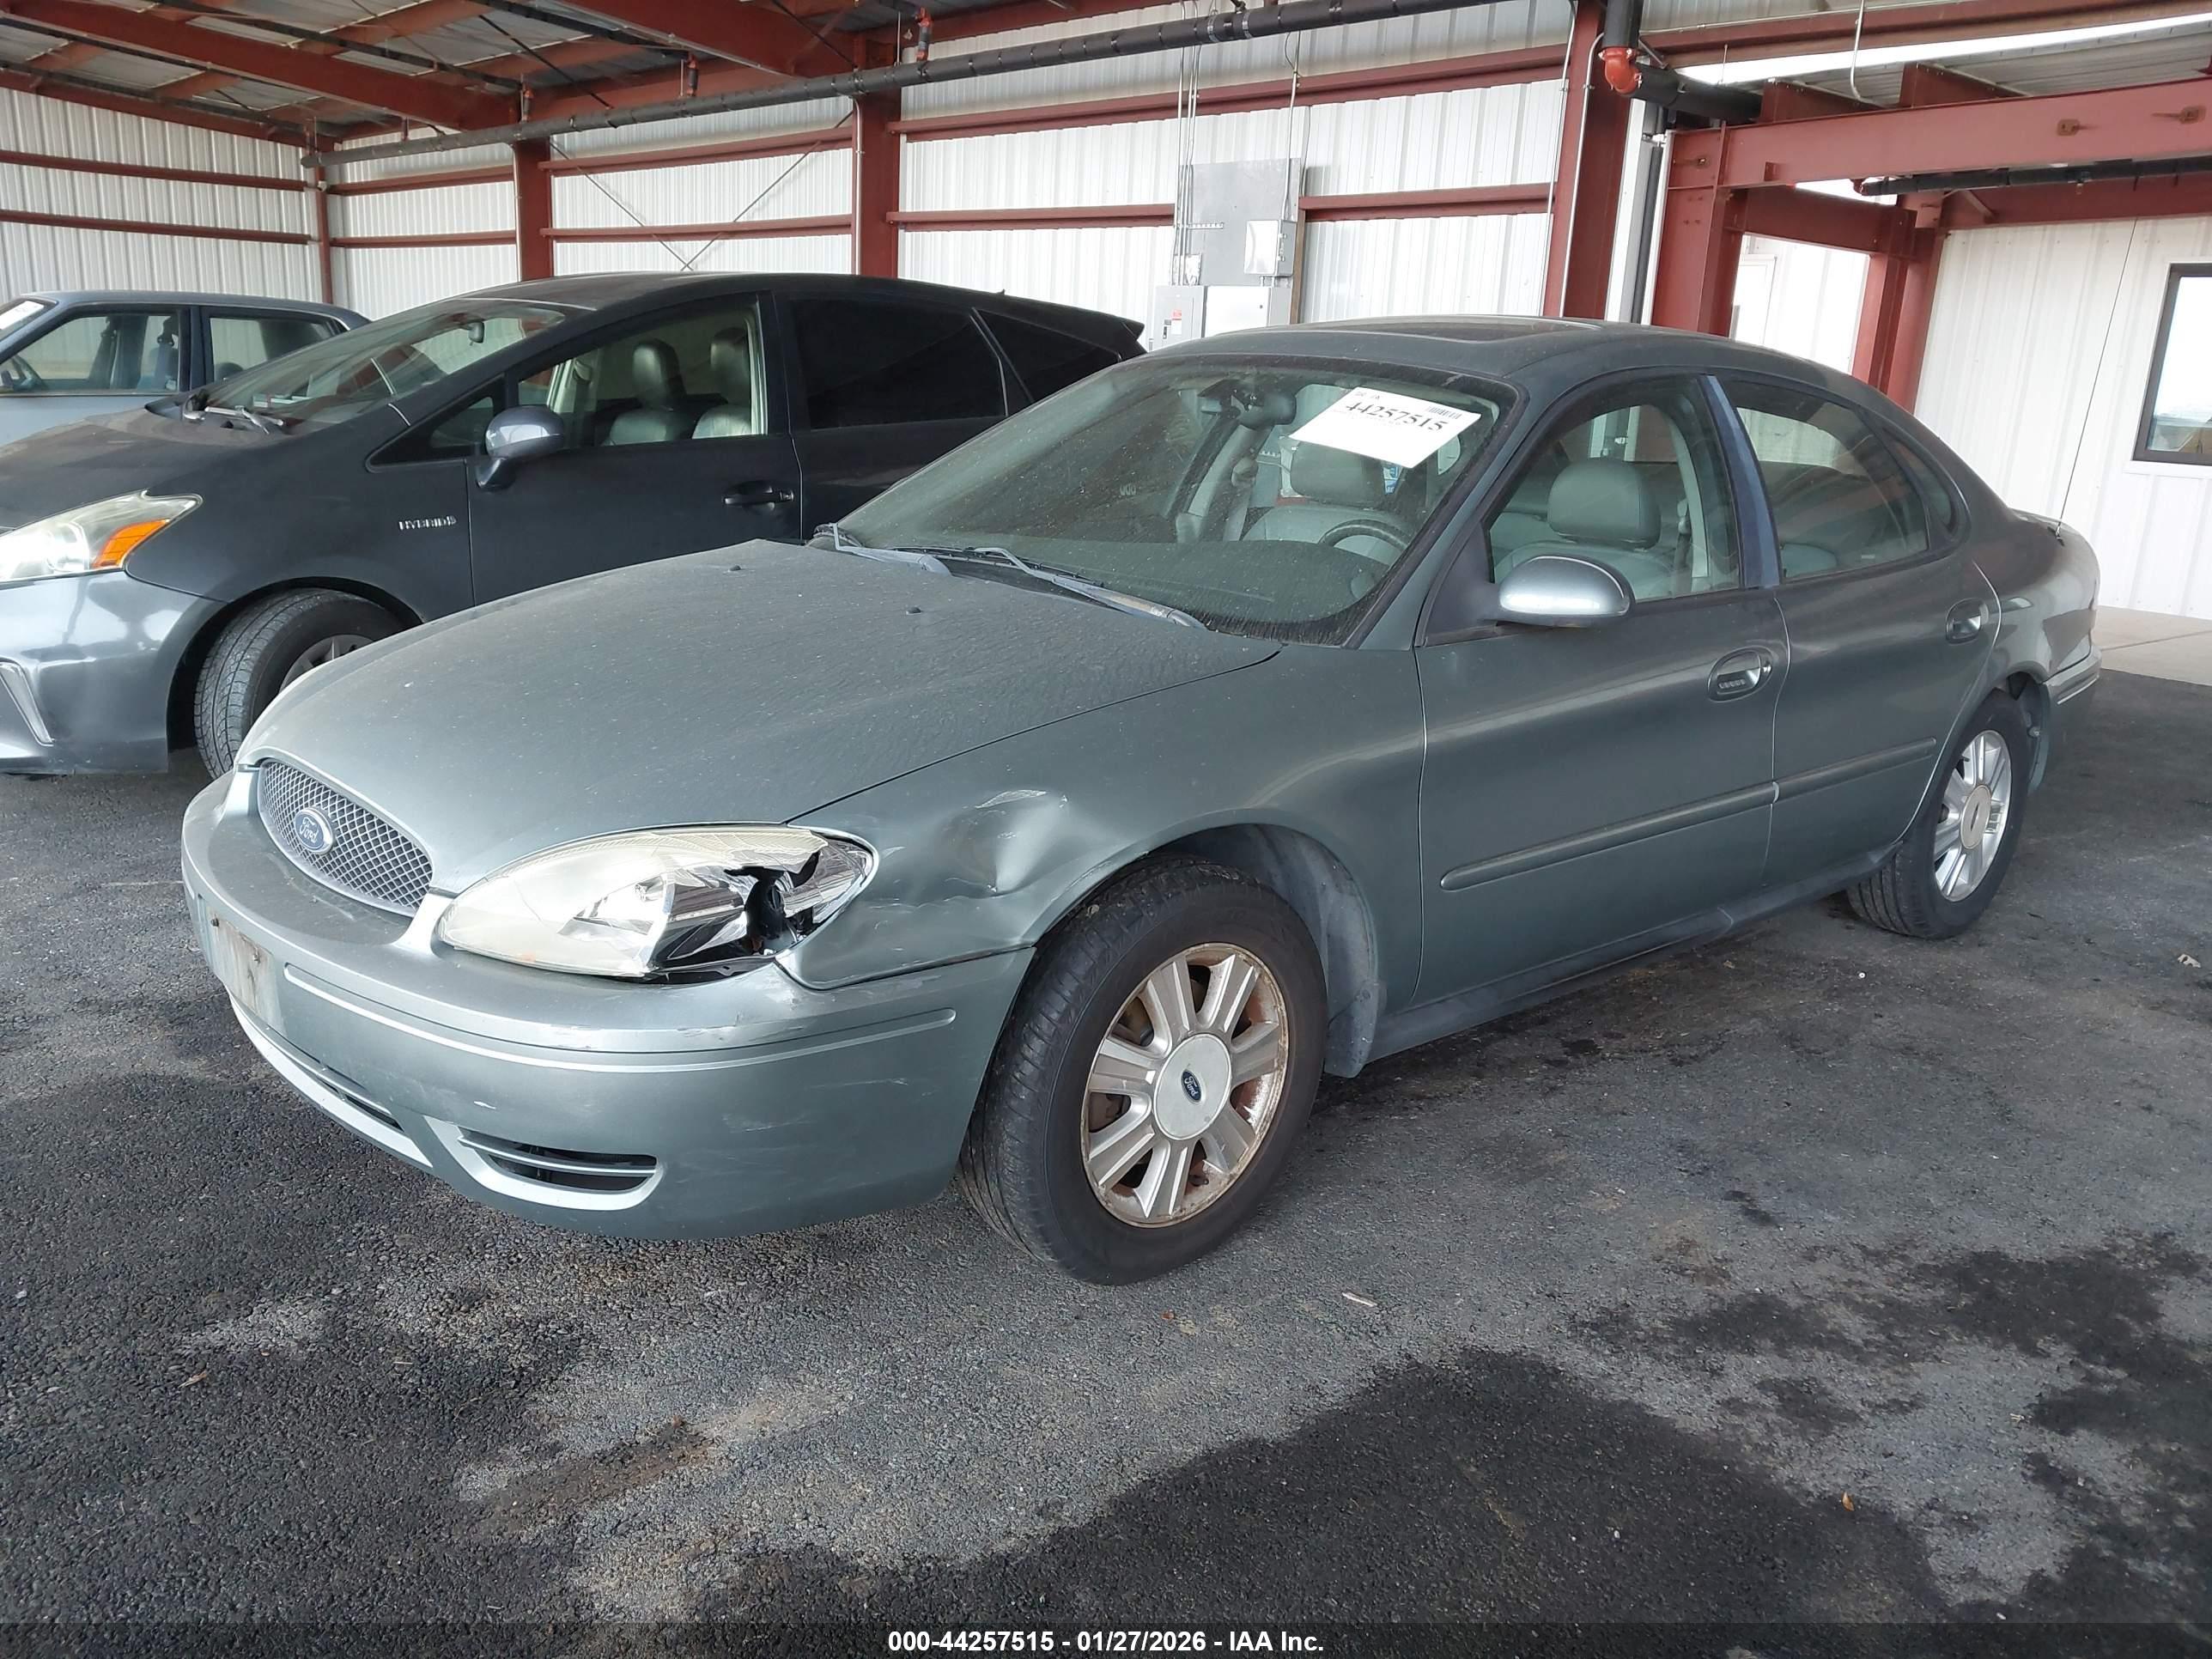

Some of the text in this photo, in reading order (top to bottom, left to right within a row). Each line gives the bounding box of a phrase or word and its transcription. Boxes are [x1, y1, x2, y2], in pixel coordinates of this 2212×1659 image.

[1346, 402, 1449, 431] 44257515
[299, 816, 319, 843] Ford
[1184, 1076, 1199, 1097] Ford
